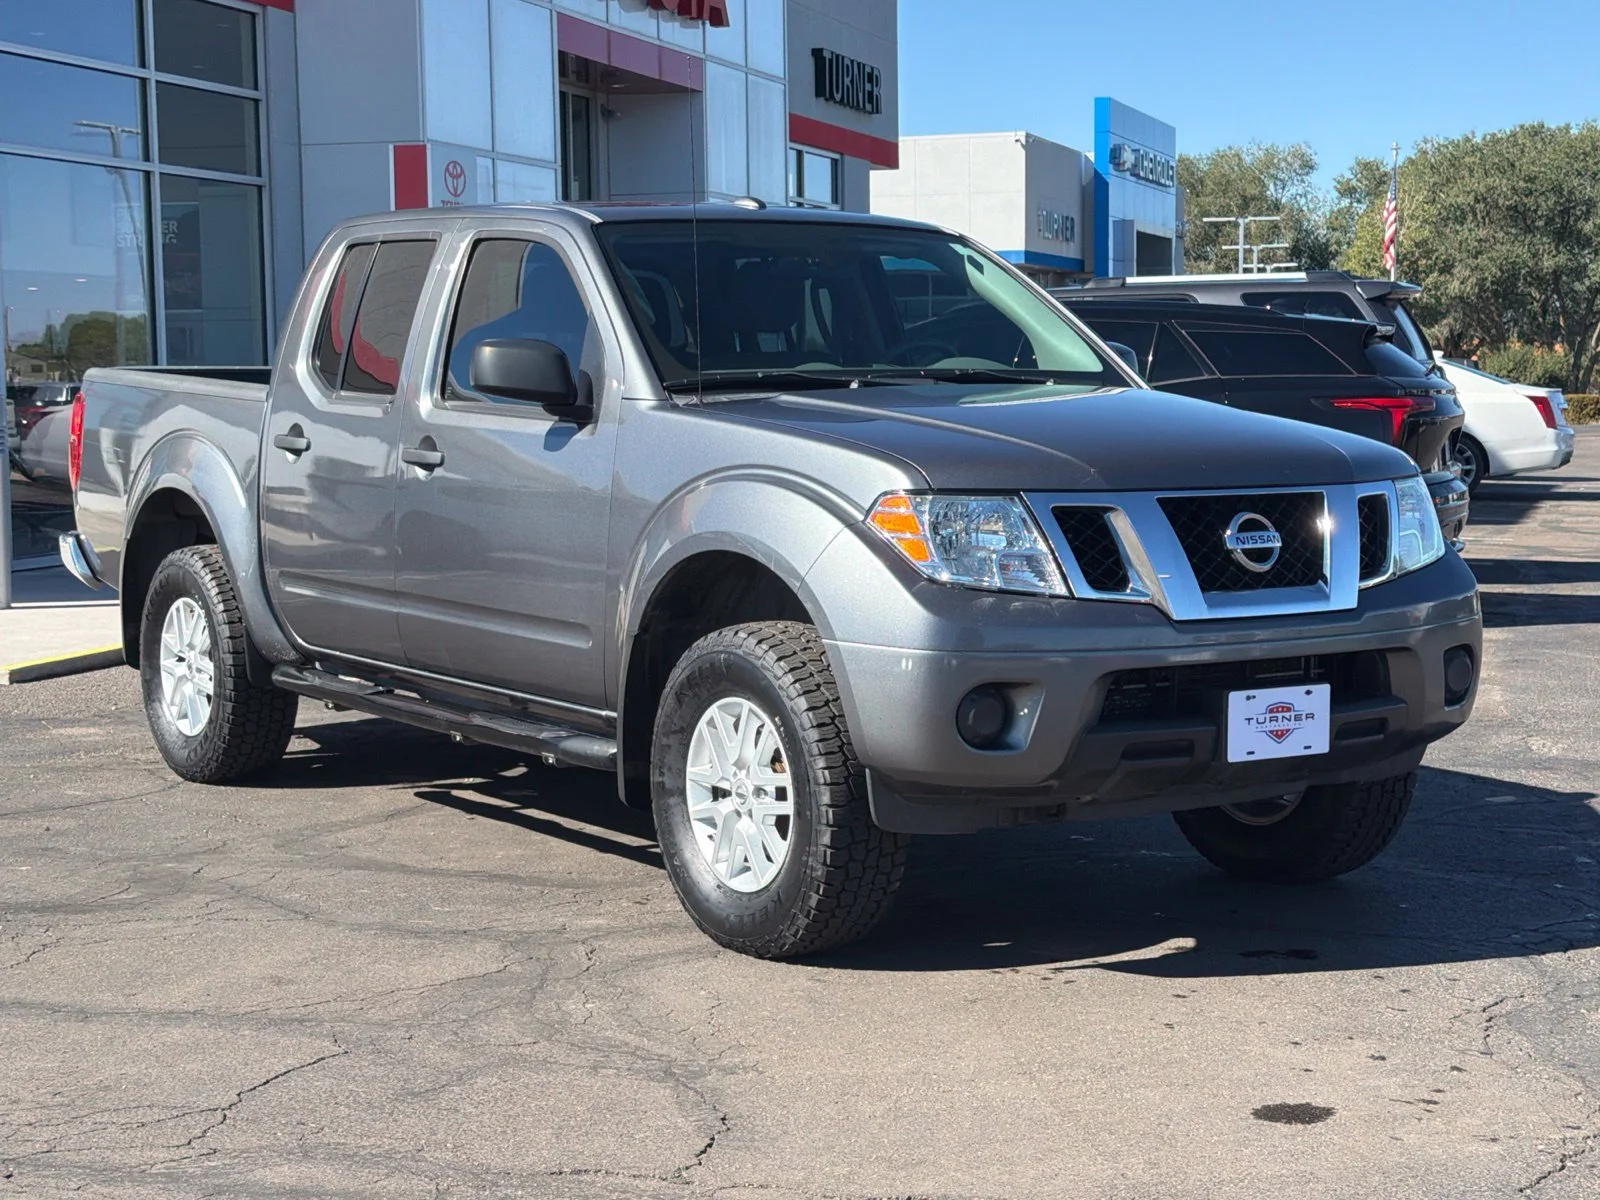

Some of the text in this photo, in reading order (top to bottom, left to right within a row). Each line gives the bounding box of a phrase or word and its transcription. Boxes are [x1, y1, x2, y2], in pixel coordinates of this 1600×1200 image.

[812, 48, 882, 114] TURNER
[1235, 534, 1280, 546] NISSAN
[1244, 712, 1315, 726] TURNER
